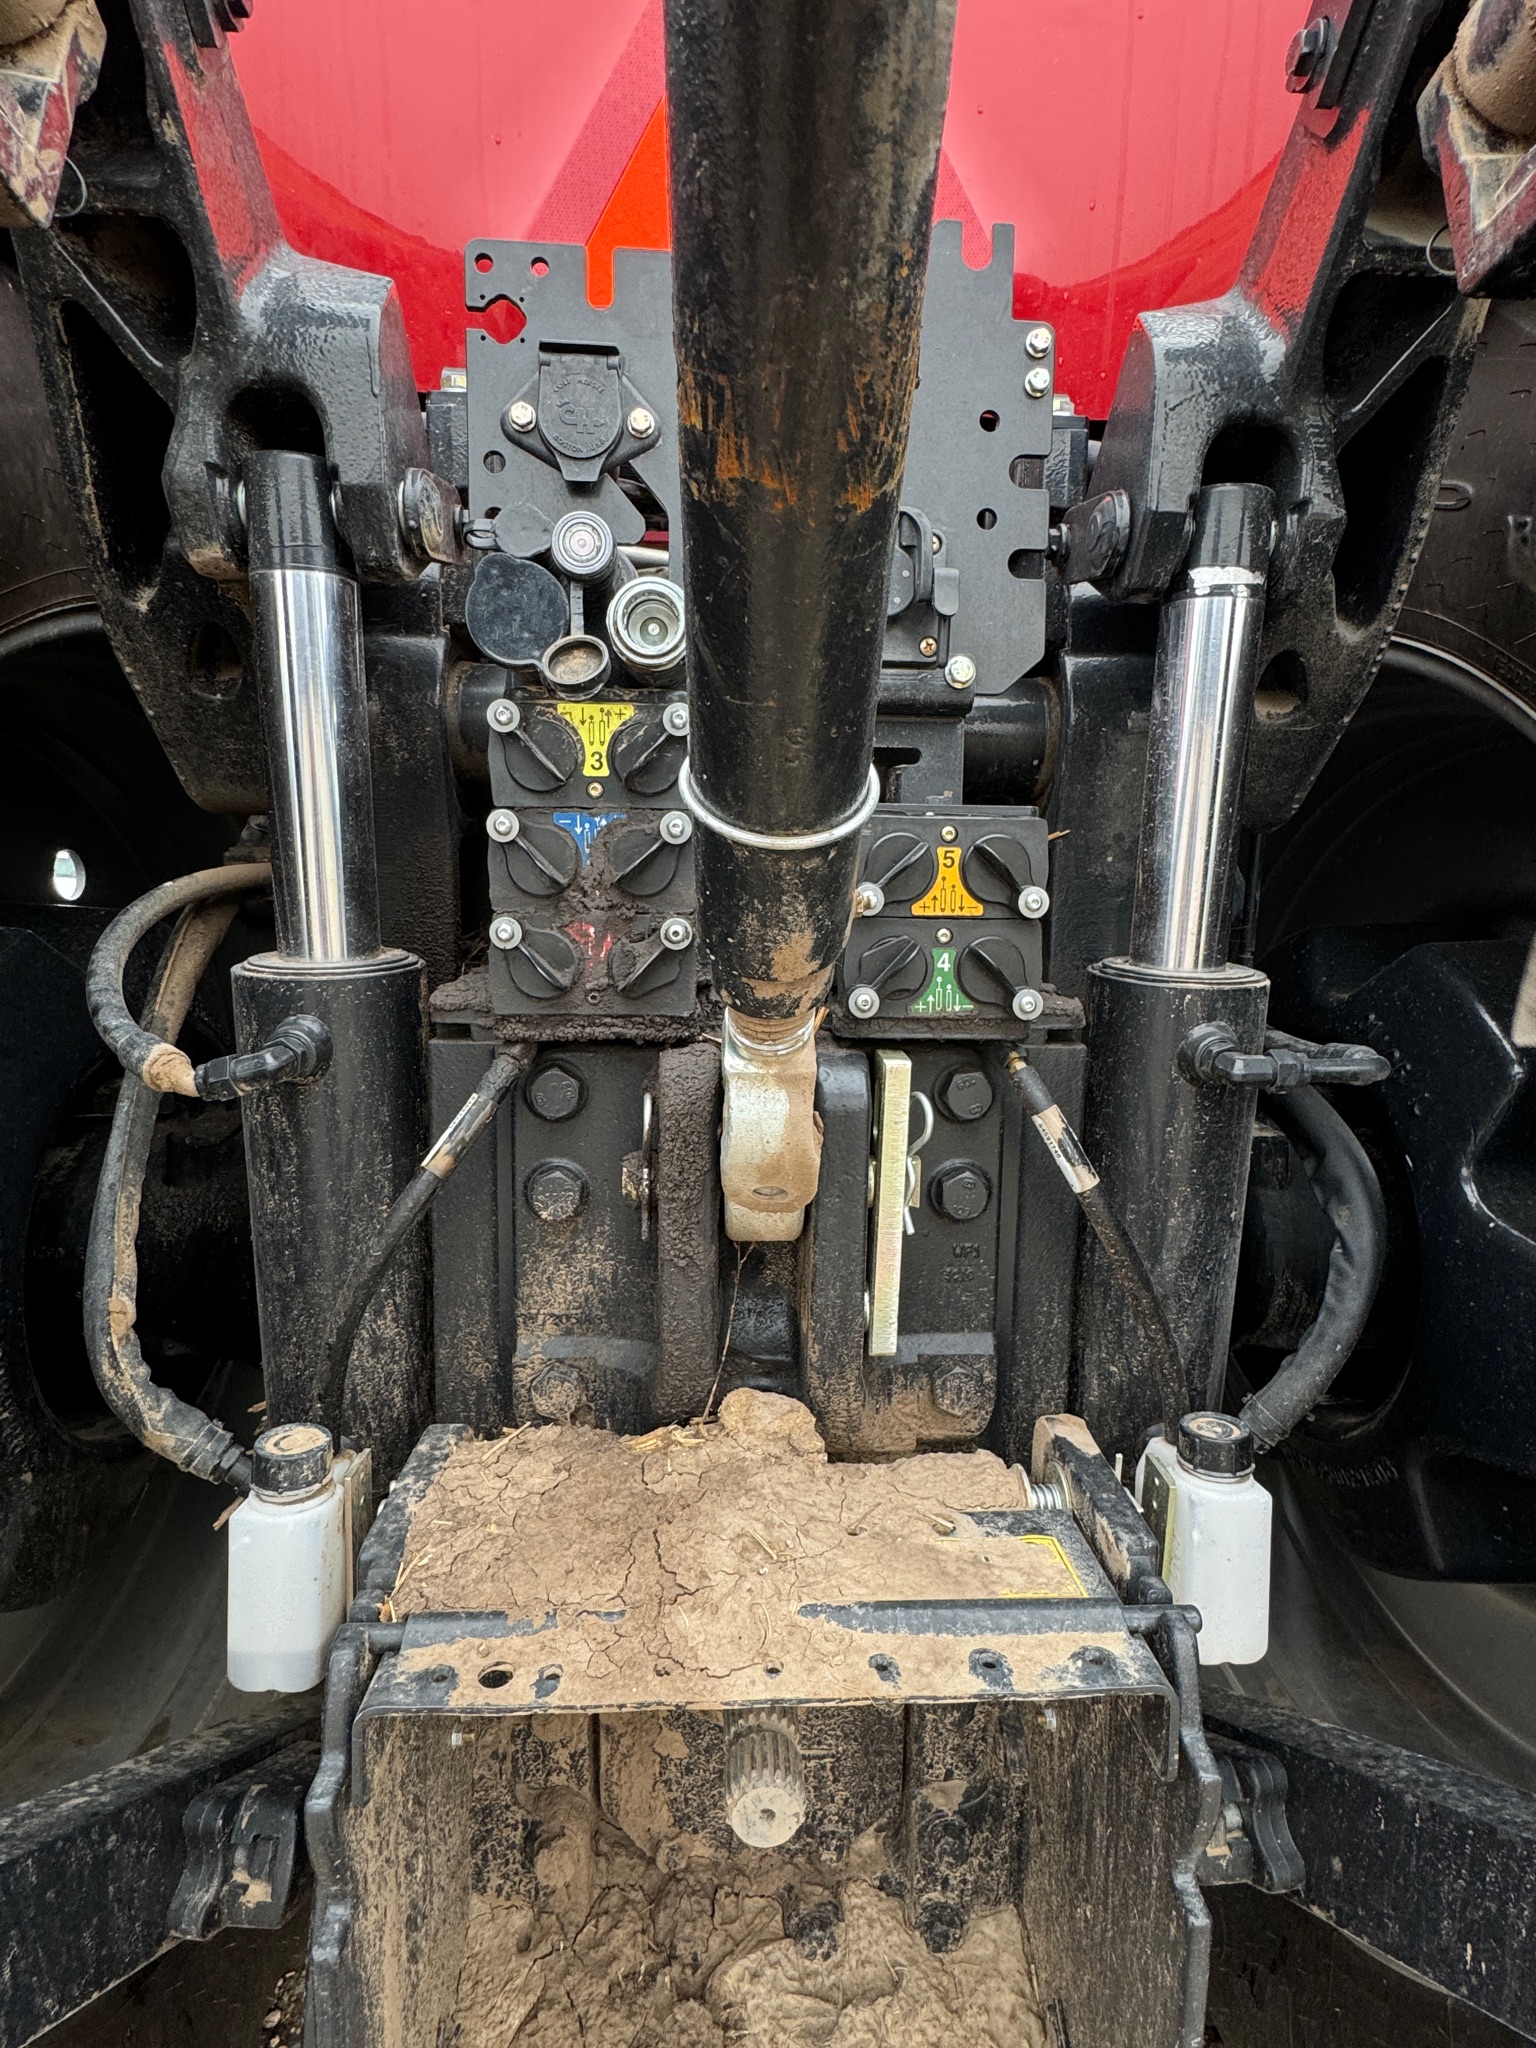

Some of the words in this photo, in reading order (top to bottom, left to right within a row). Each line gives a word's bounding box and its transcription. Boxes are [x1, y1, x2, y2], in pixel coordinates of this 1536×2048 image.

[591, 752, 603, 770] 3
[943, 850, 955, 868] 5
[937, 953, 951, 972] 4
